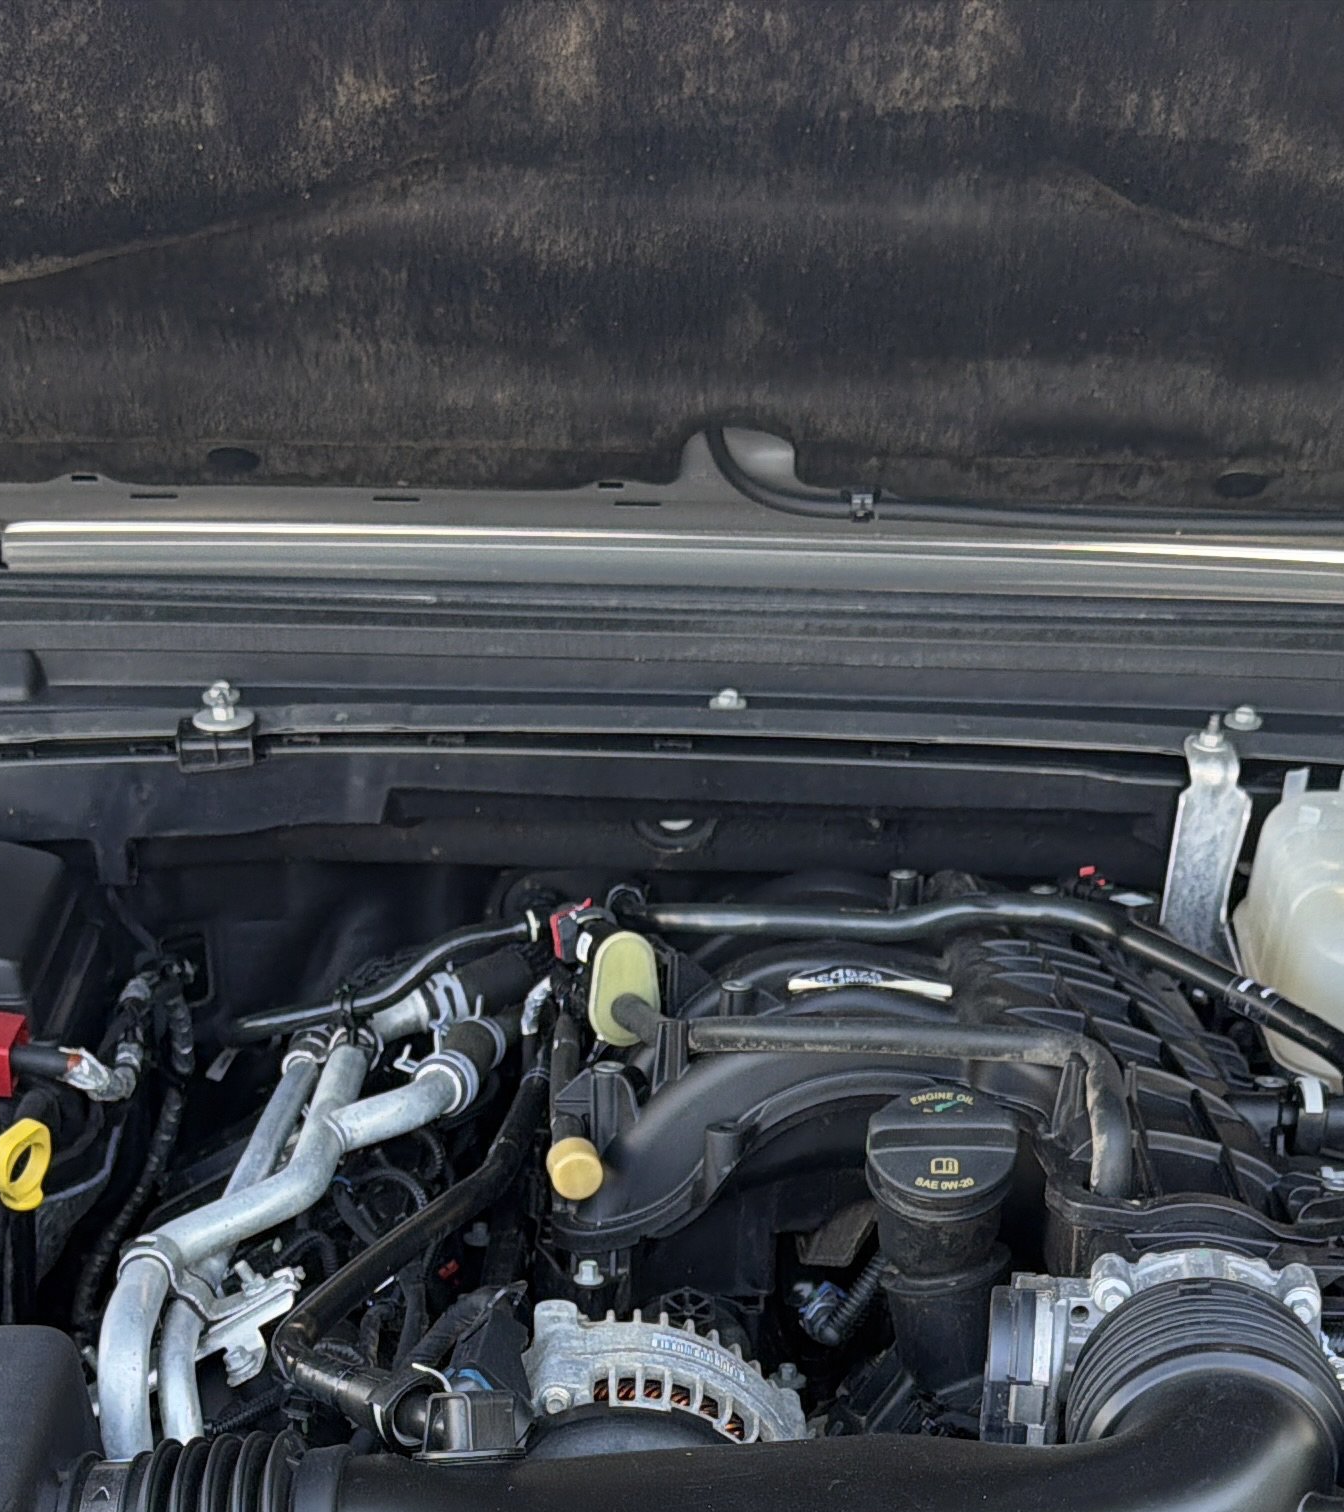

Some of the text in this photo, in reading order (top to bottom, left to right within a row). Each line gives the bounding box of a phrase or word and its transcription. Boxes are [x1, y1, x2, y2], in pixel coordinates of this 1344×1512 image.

[910, 1092, 975, 1106] ENGINE OIL
[914, 1176, 975, 1191] SAE 0W-20
